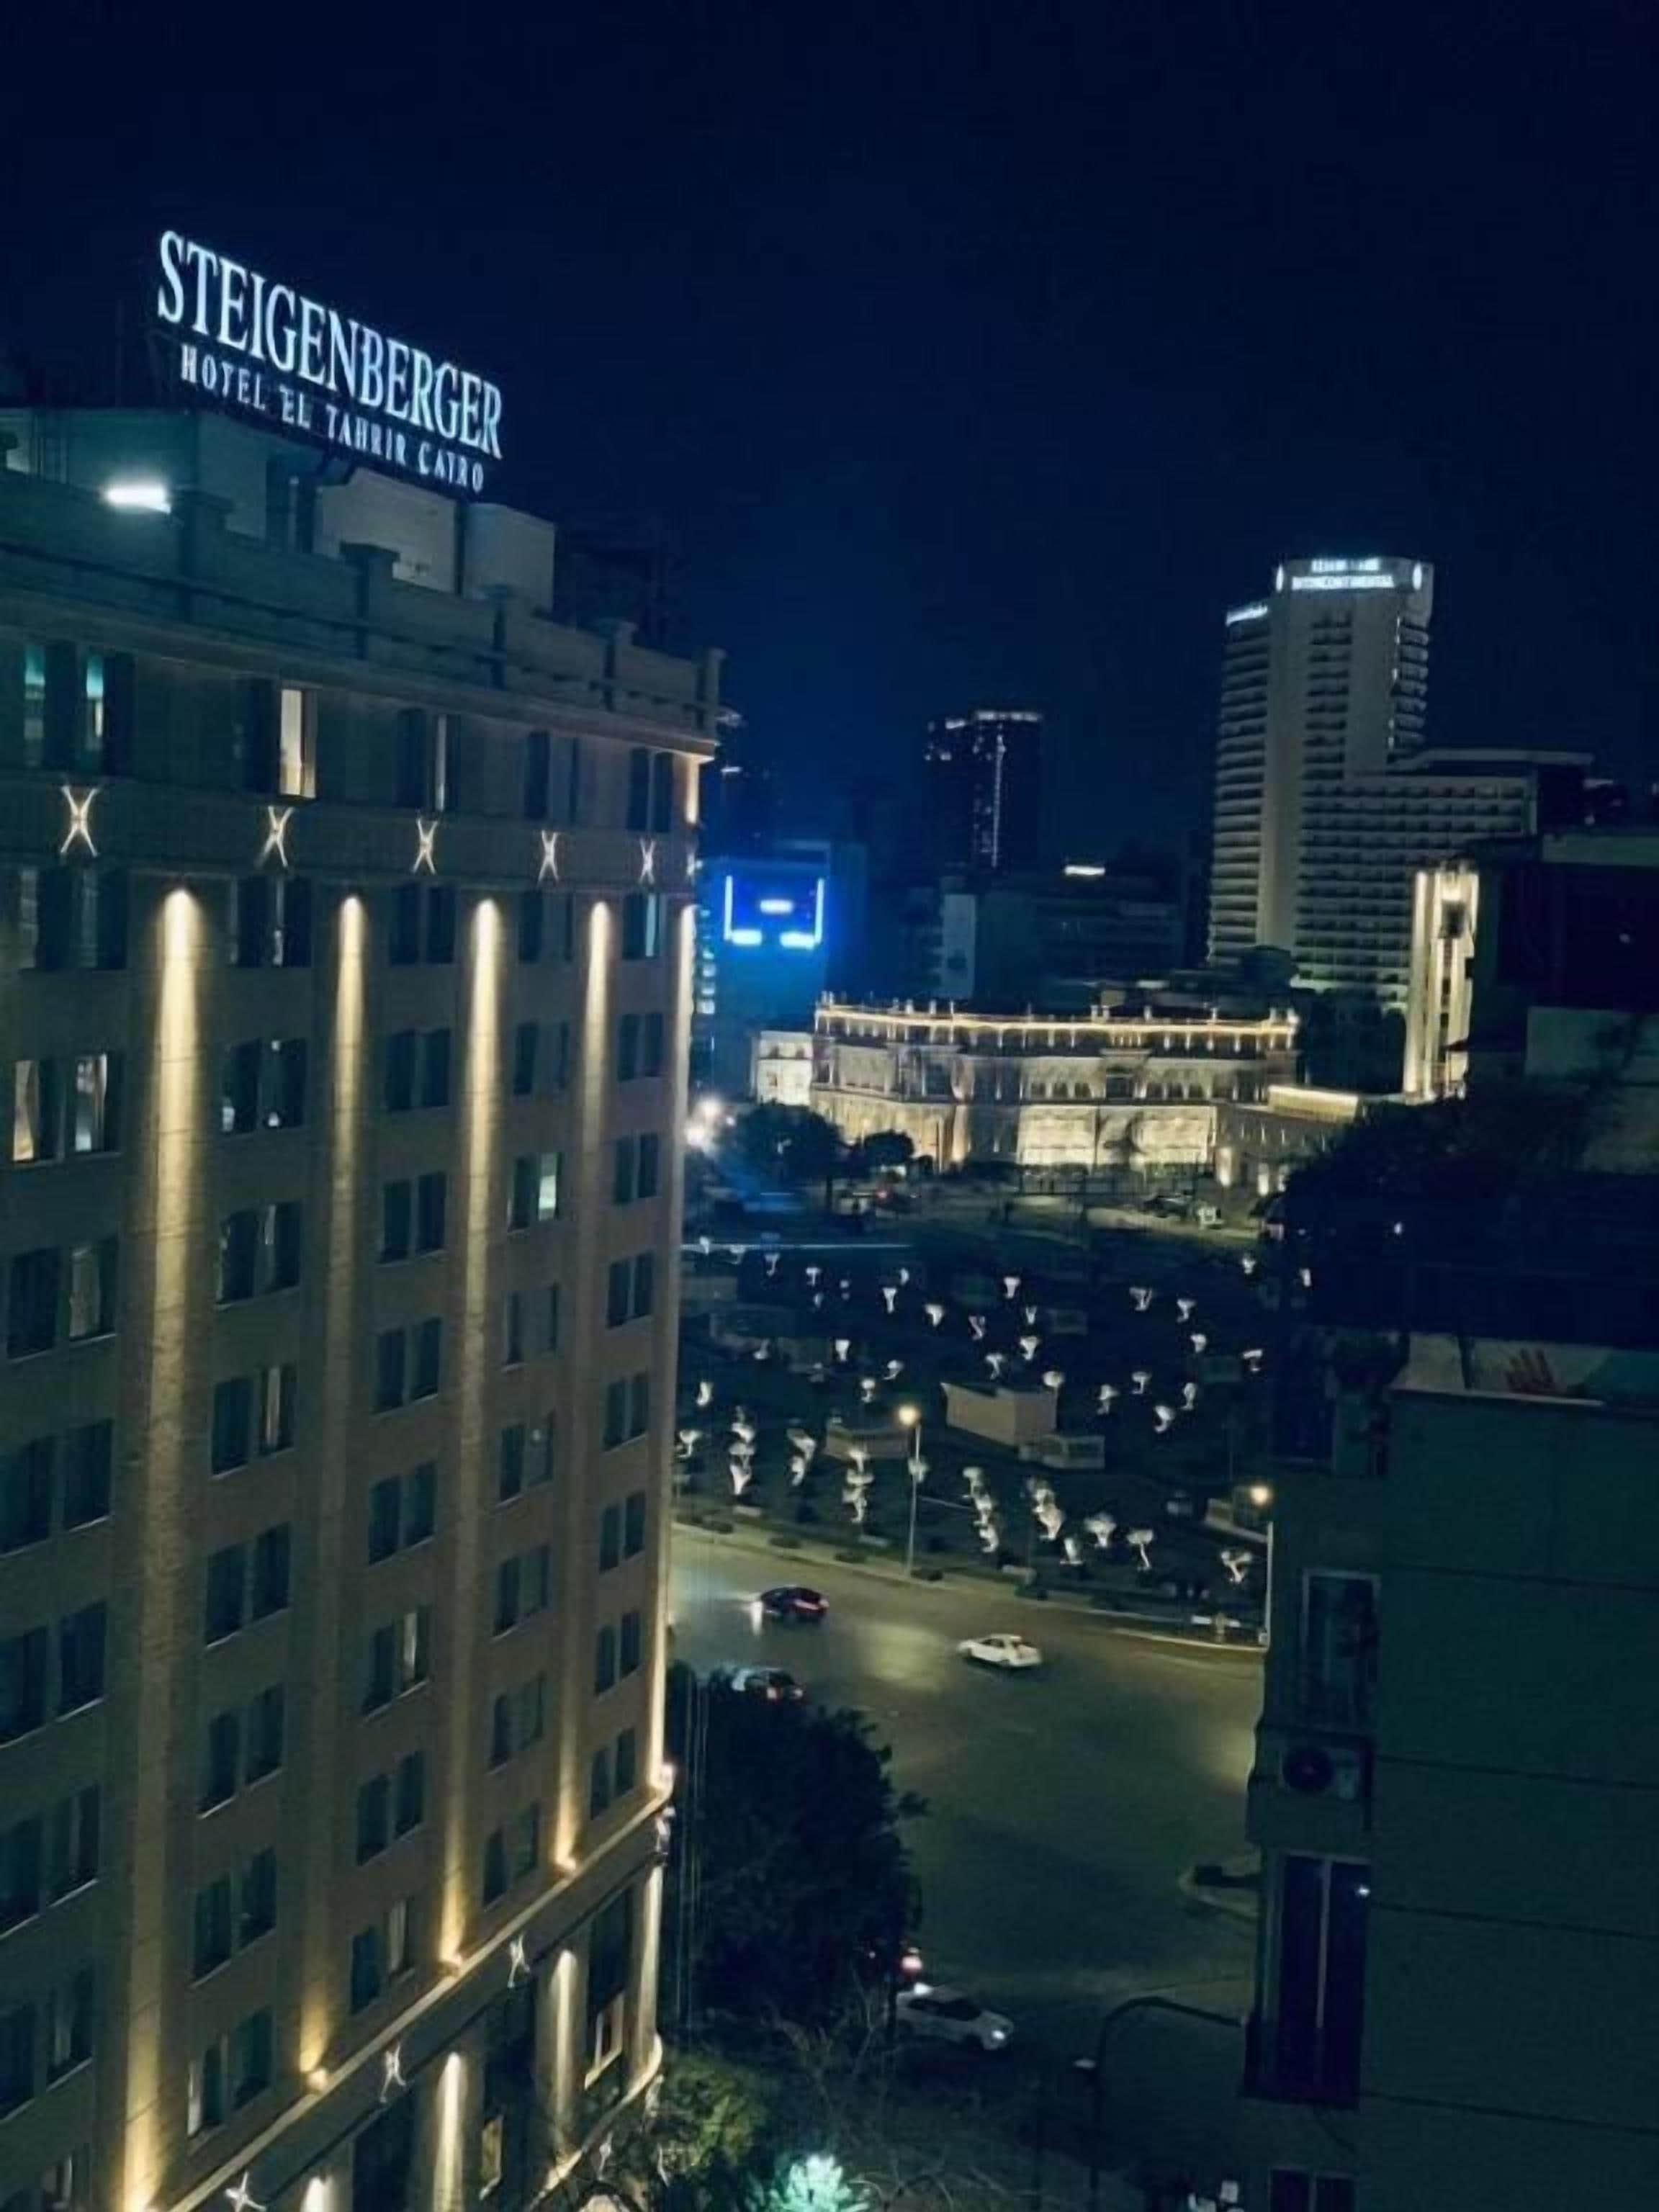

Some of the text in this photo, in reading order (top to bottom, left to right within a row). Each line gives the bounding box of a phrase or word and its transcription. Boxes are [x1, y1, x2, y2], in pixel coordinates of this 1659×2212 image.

[158, 230, 503, 459] STEIGENBERGER
[181, 343, 484, 493] HOTEL EL TAHRIR CAIRO
